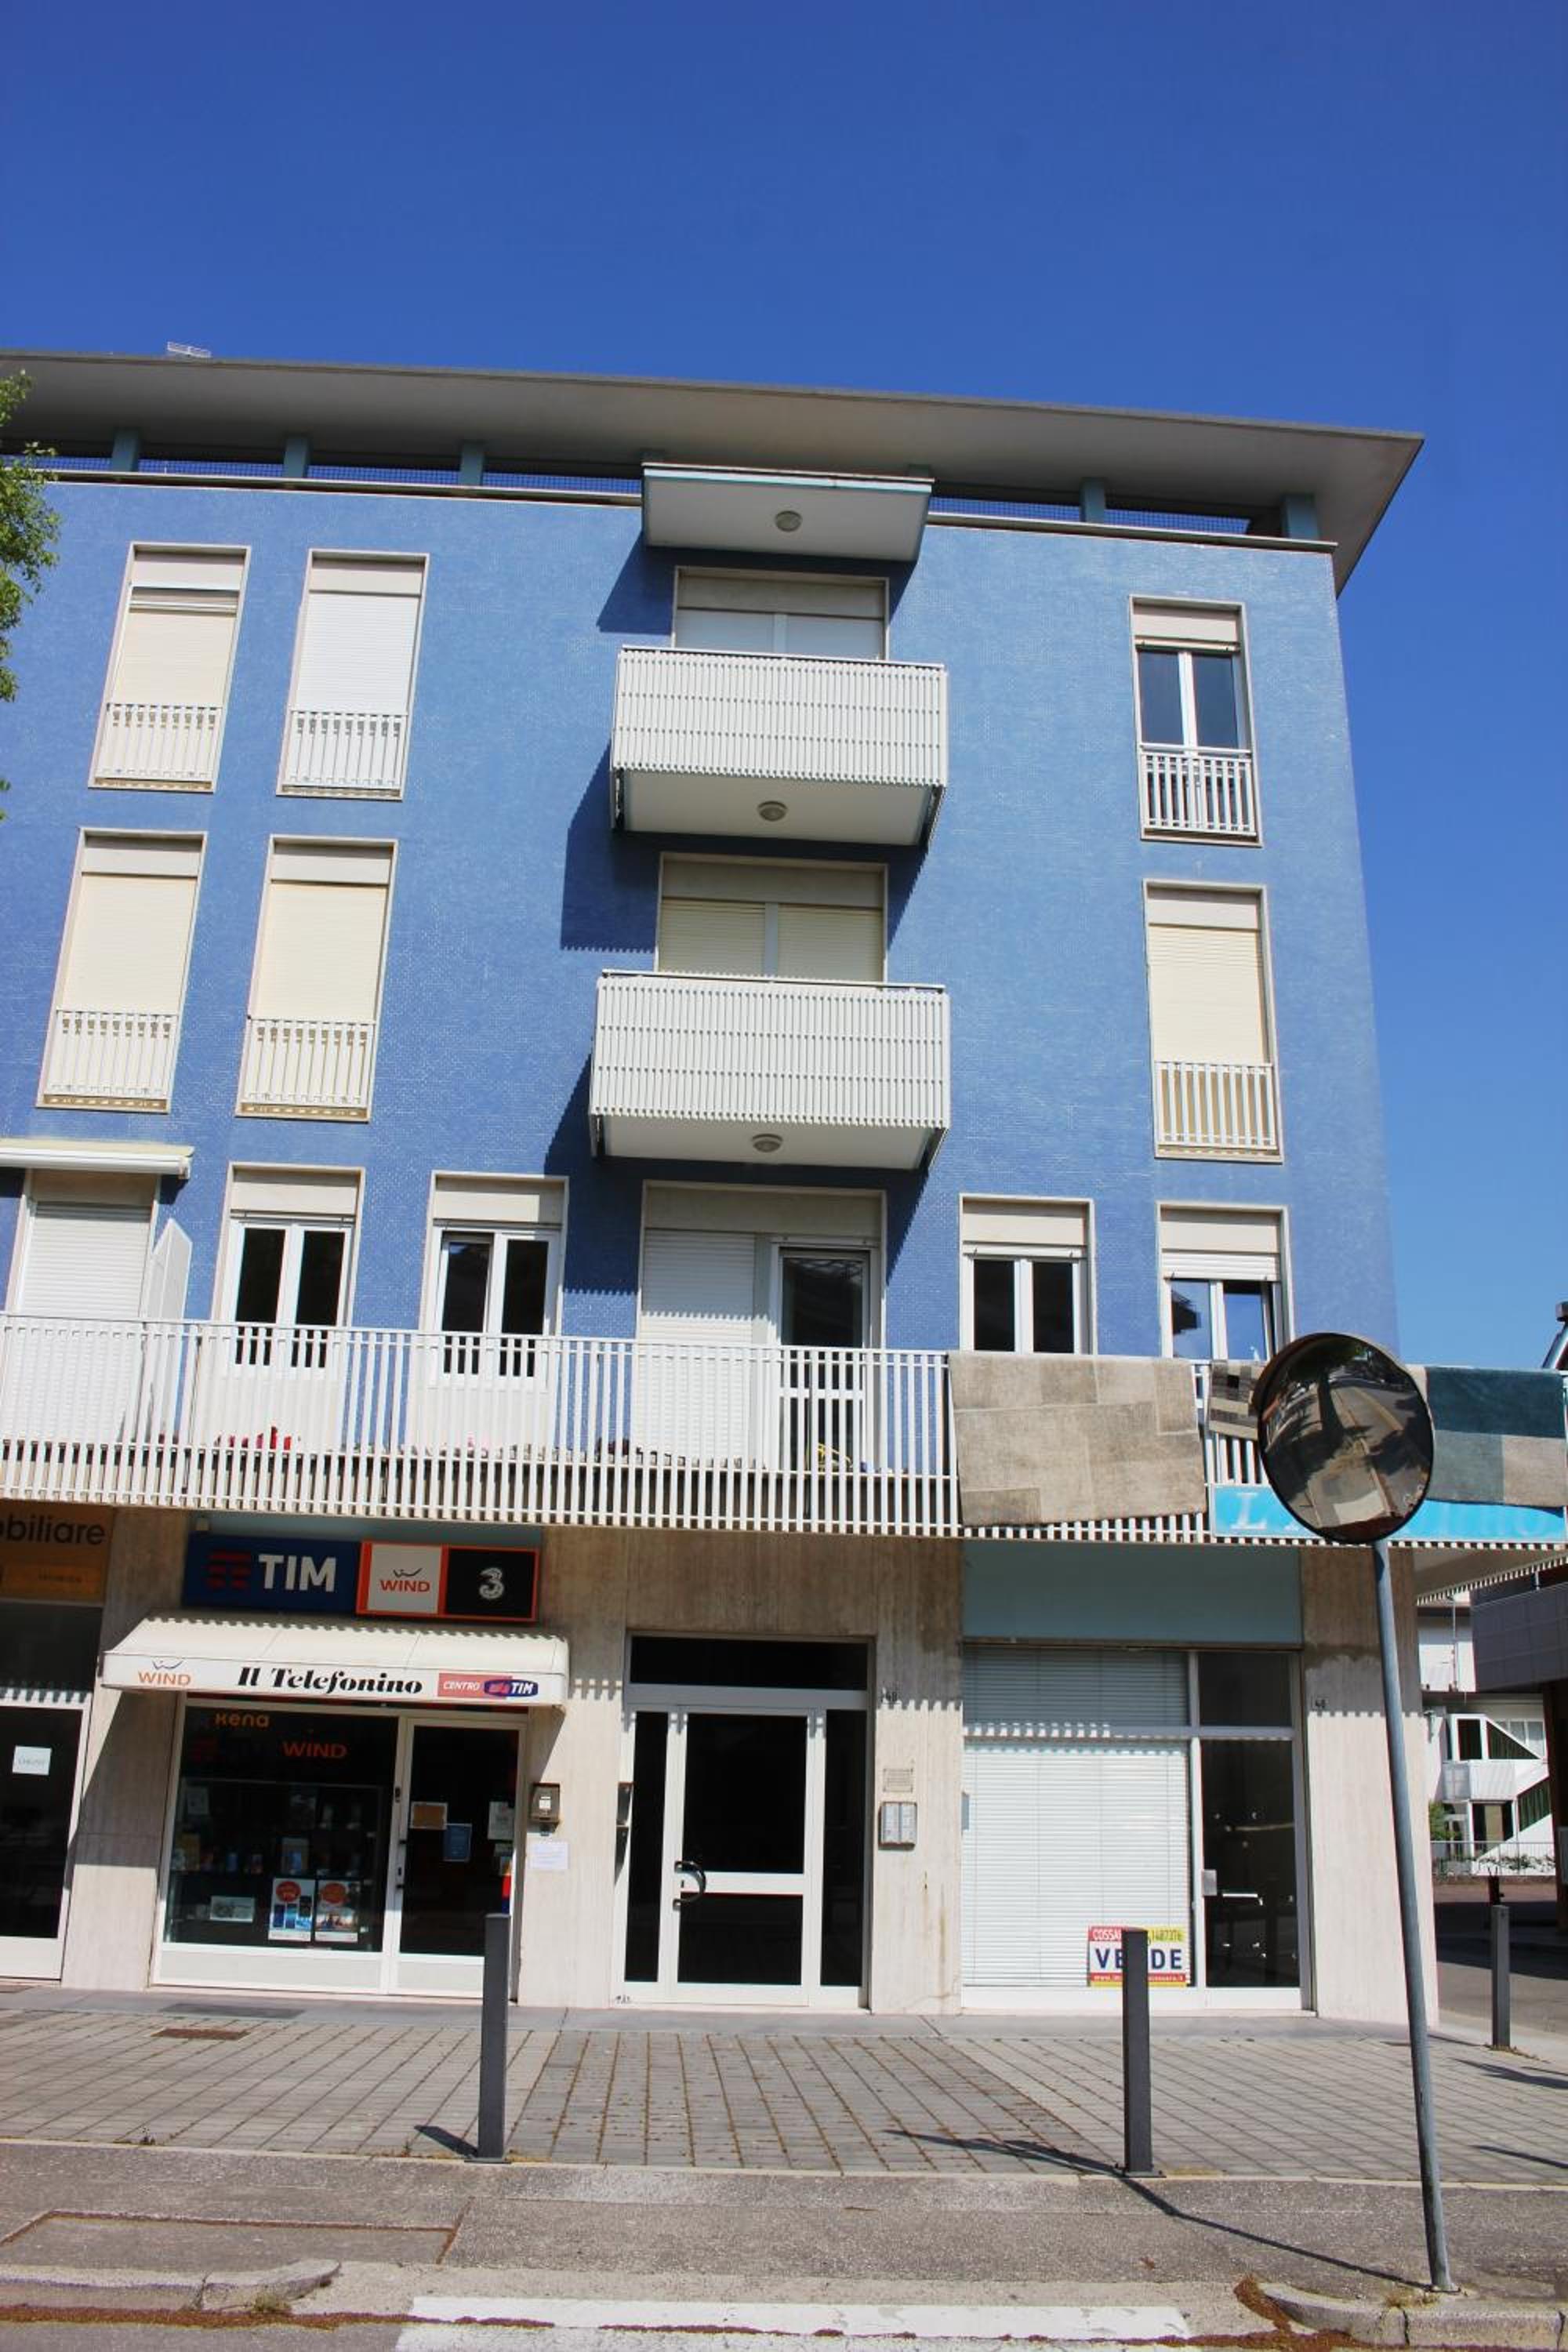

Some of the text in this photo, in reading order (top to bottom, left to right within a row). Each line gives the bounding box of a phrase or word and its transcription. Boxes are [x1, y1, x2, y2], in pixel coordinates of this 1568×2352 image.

[0, 1512, 106, 1545] biliare
[258, 1554, 337, 1592] TIM
[479, 1567, 505, 1600] 3
[379, 1579, 430, 1593] WIND
[138, 1671, 192, 1686] WIND
[238, 1666, 424, 1695] Il Telefonino
[443, 1680, 534, 1695] CENTRO TIM
[281, 1740, 348, 1759] WIND
[1094, 1947, 1183, 1970] VEDE
